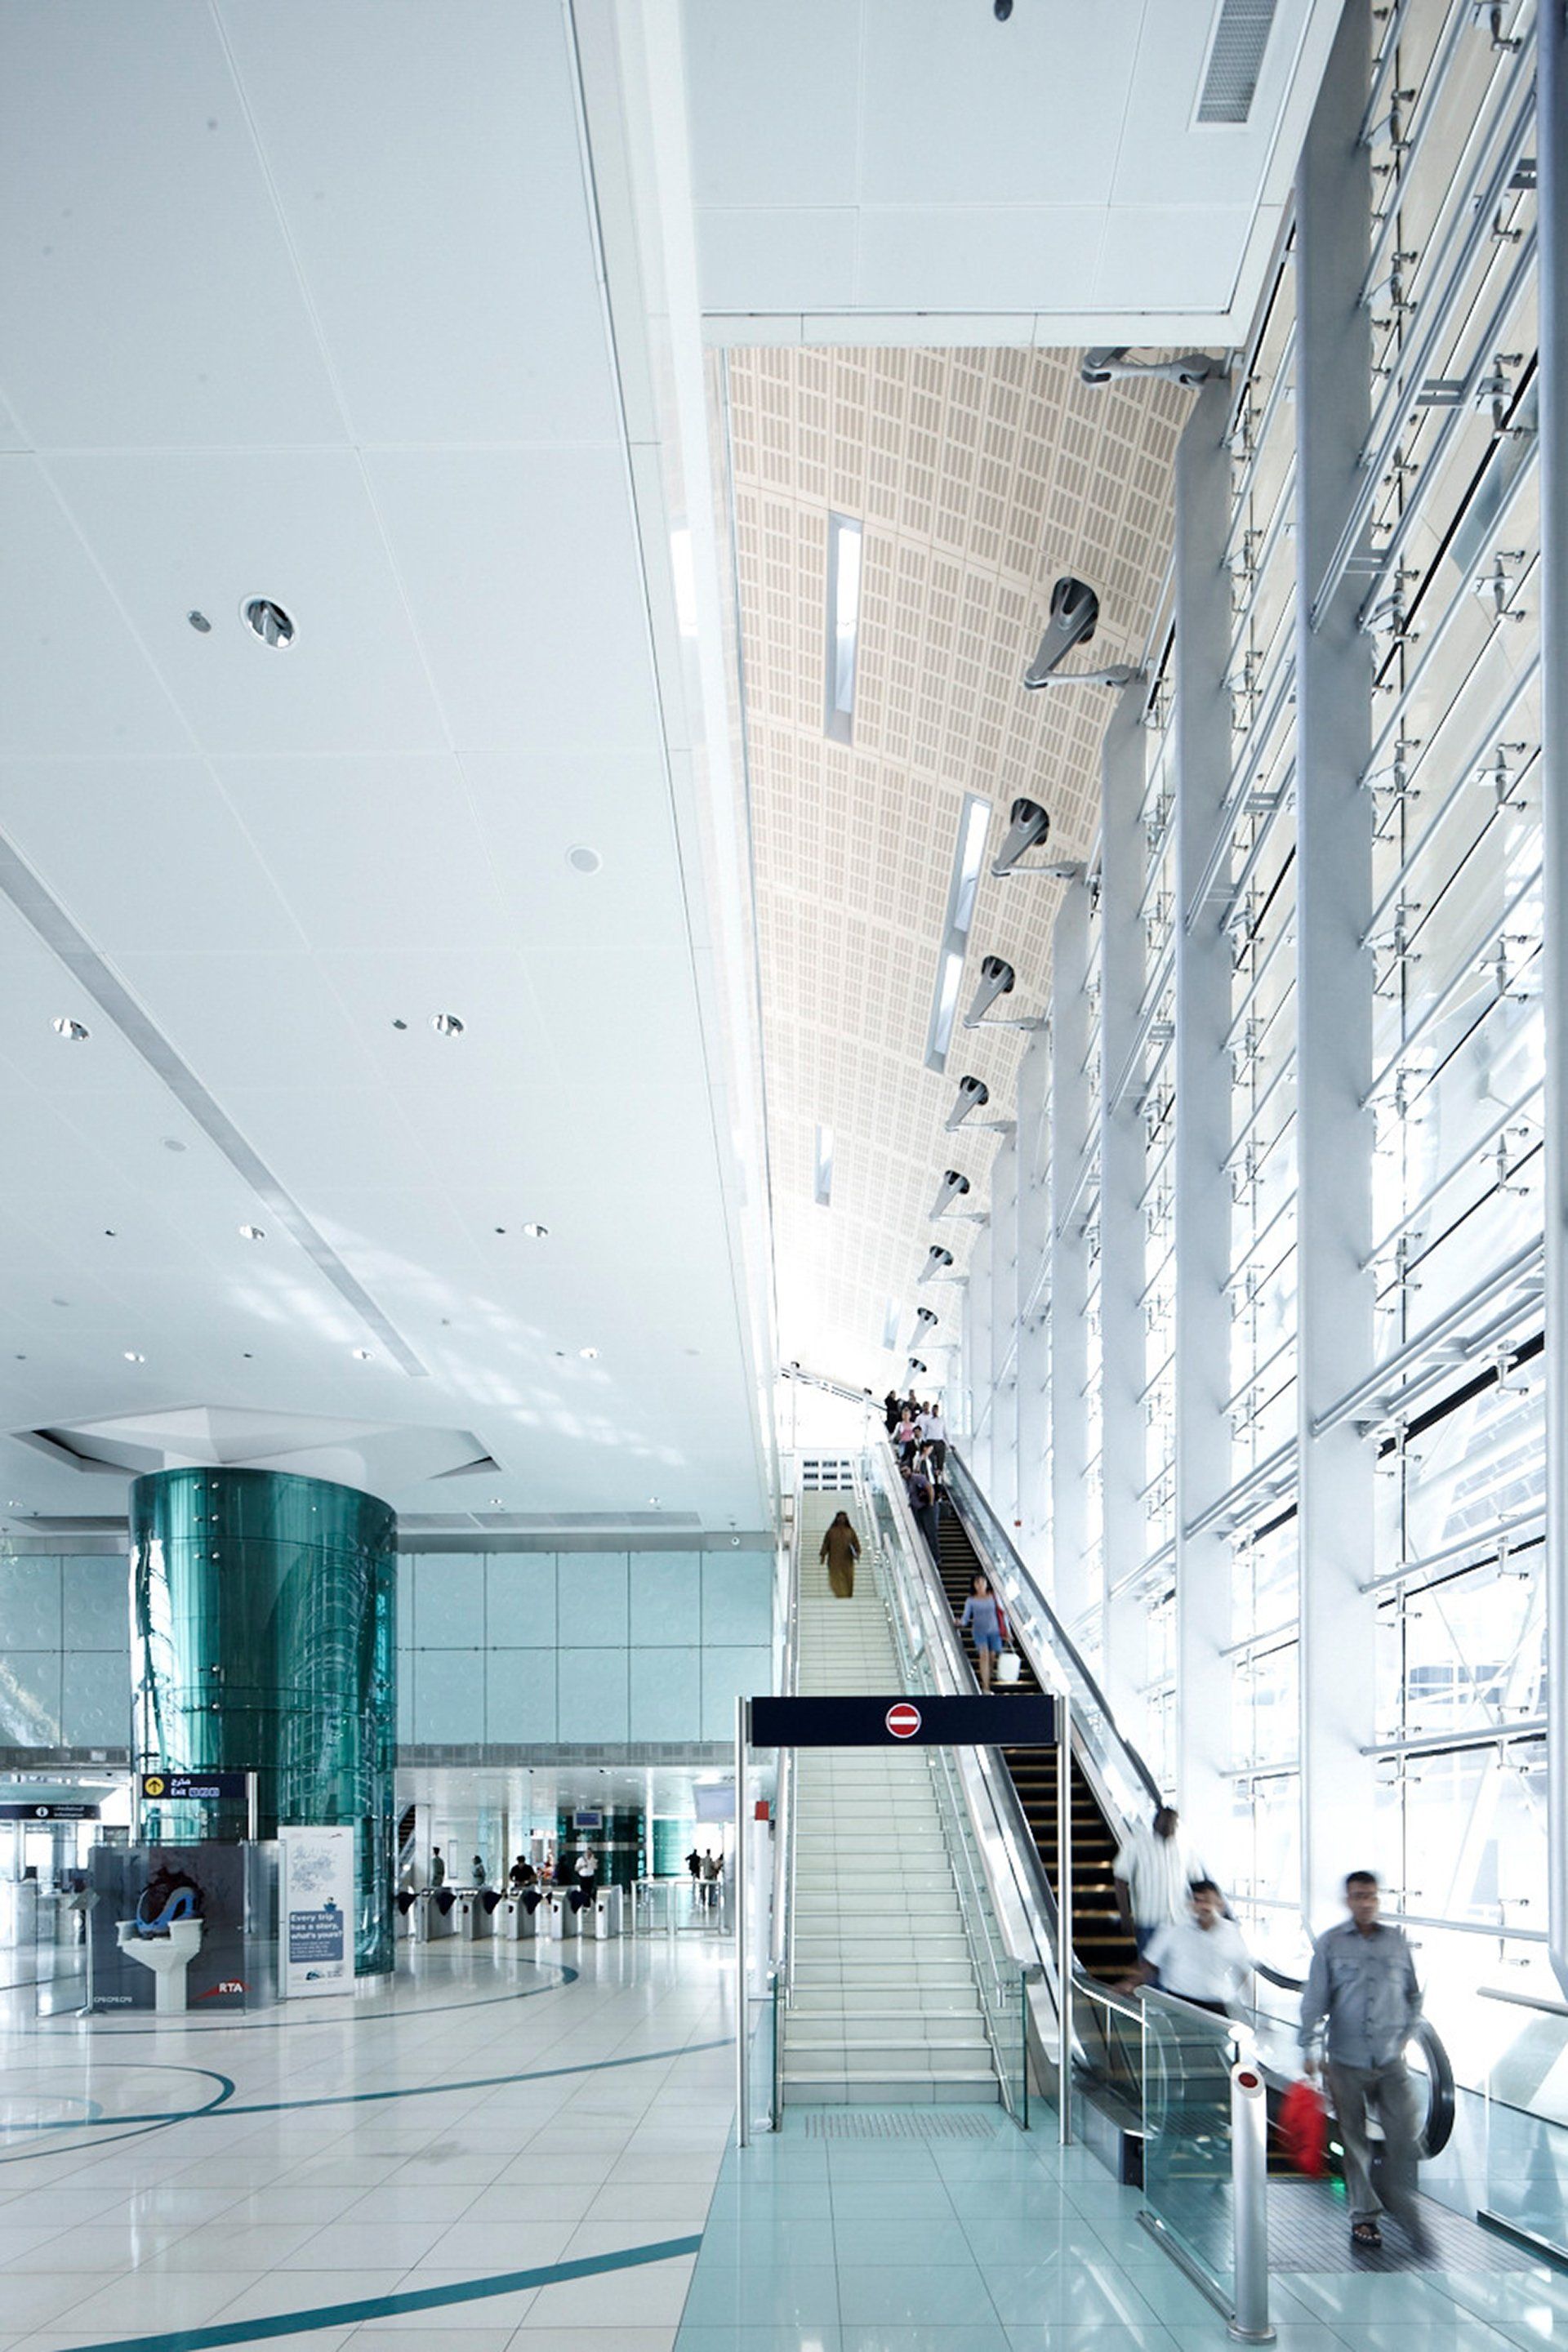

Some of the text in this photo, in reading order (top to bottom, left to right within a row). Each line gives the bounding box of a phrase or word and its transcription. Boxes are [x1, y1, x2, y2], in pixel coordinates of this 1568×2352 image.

[171, 1788, 186, 1796] Exit
[318, 1913, 334, 1922] trip
[318, 1930, 343, 1940] yours?
[219, 1983, 243, 1993] RTA
